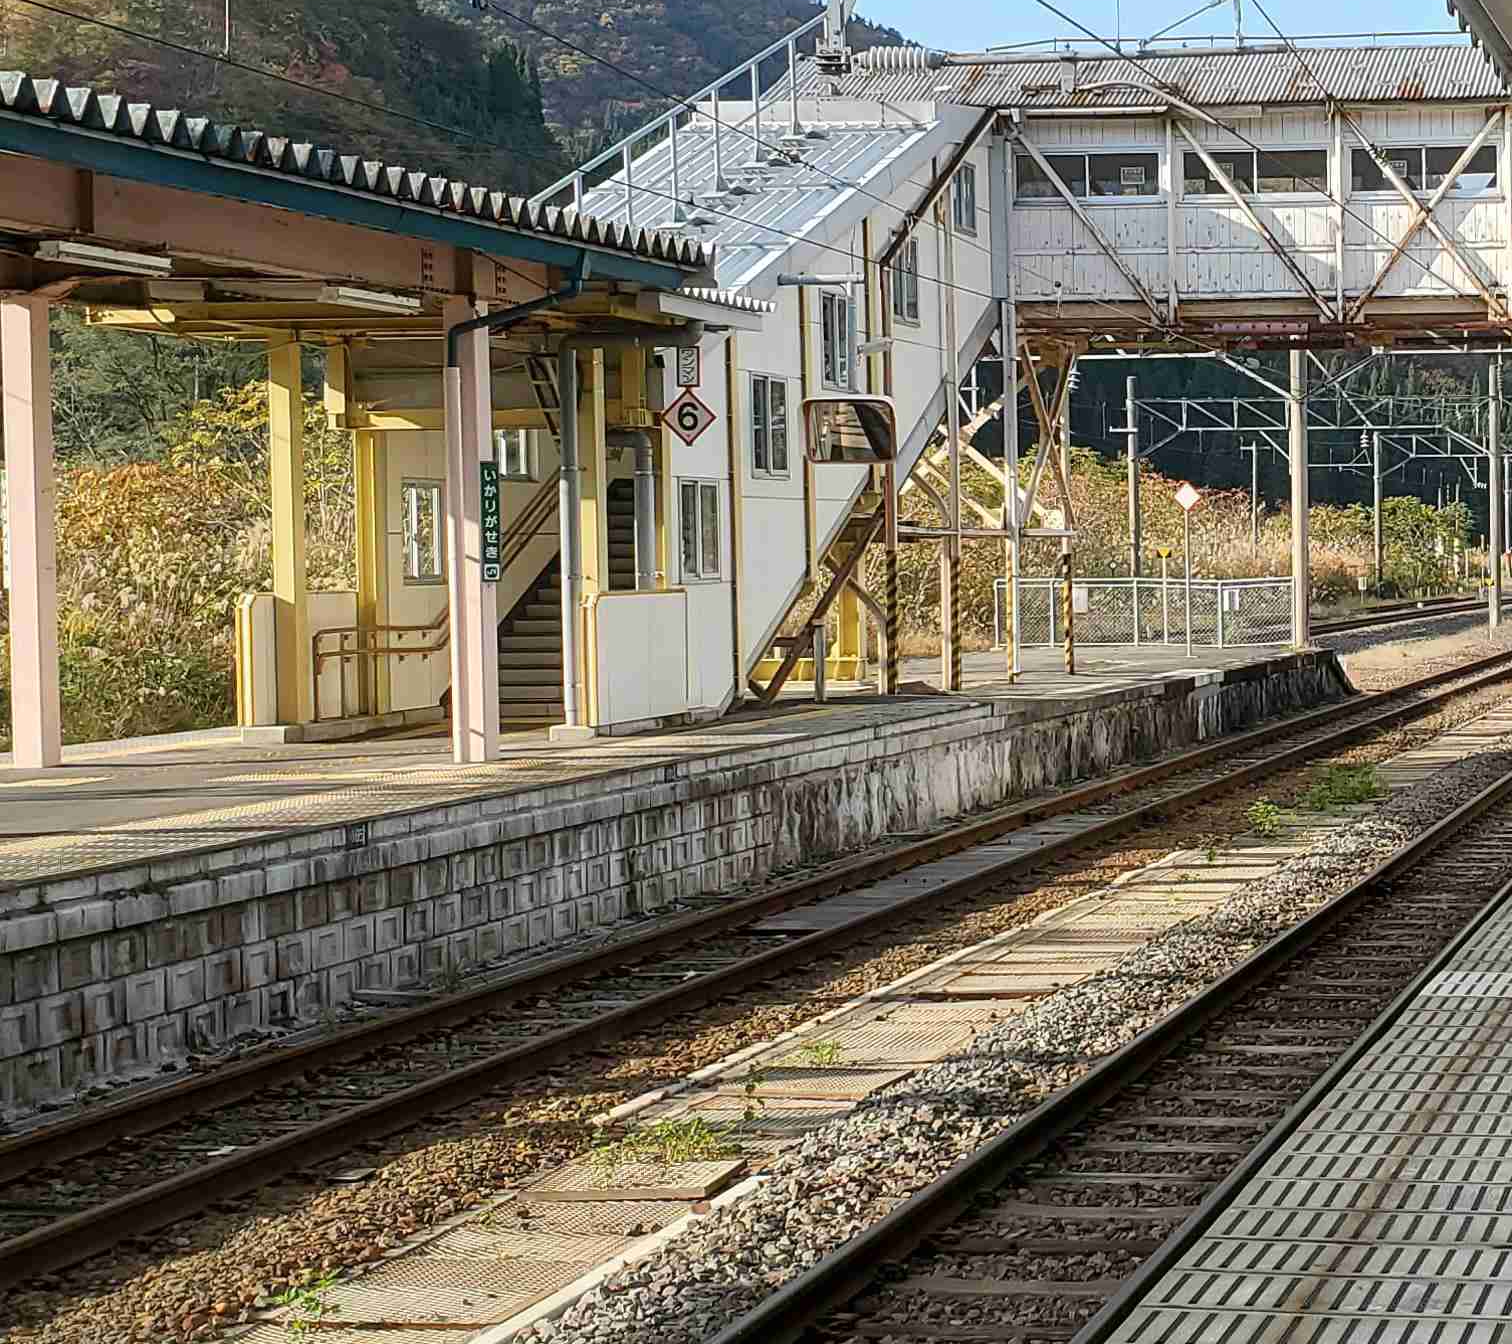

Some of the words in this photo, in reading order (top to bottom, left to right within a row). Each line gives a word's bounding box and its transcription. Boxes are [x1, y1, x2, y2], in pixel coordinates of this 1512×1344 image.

[678, 402, 699, 431] 6
[484, 469, 498, 559] いかりがせき
